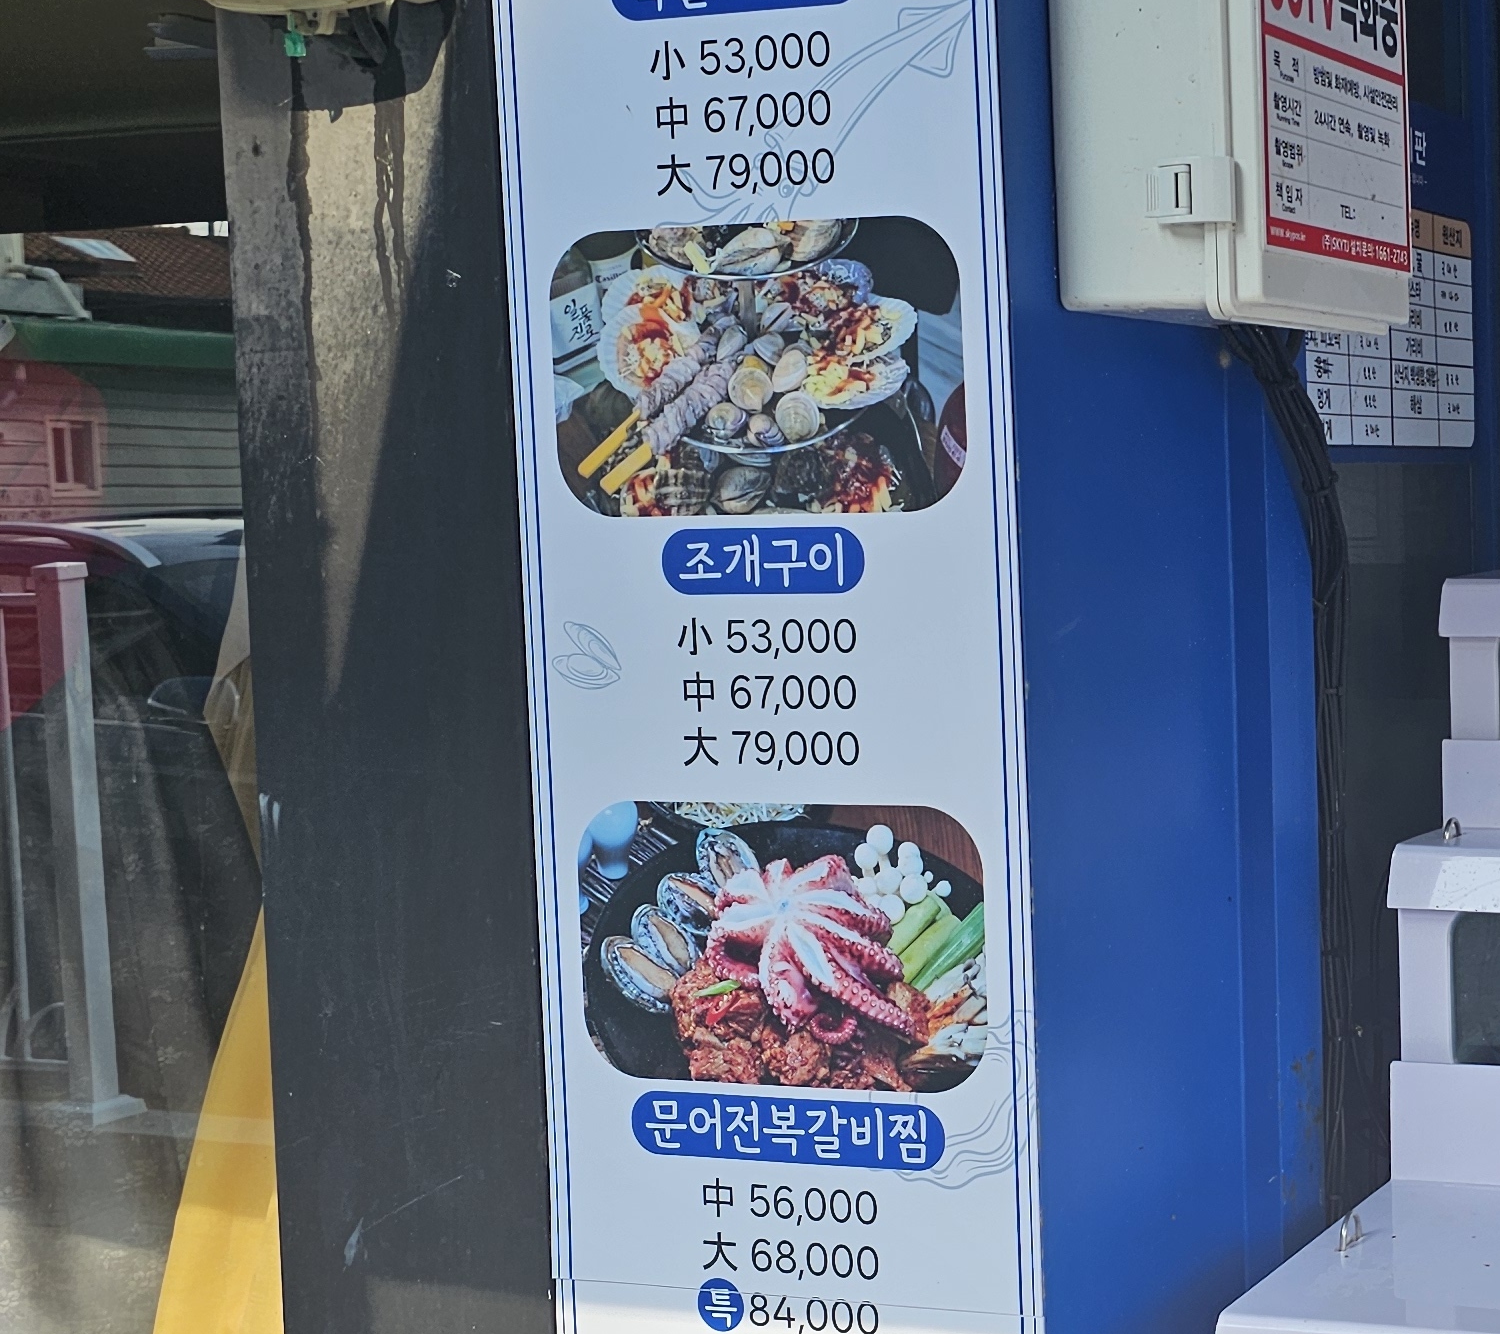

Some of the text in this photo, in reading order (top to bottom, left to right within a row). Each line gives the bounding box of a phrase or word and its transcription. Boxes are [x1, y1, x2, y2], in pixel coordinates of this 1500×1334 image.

[650, 30, 830, 81] 小 53,000
[656, 89, 831, 139] 中 67,000
[1273, 91, 1301, 117] 촬영시간
[1314, 110, 1336, 131] 24시간
[1275, 137, 1303, 163] 촬영범위
[656, 148, 835, 197] 大 79,000
[1340, 204, 1356, 220] TEL:
[1442, 225, 1462, 249] 원산지
[564, 298, 593, 326] 일품
[569, 322, 600, 343] 진로
[679, 532, 844, 588] 조개구이
[677, 617, 857, 660] 小 53,000
[682, 671, 857, 716] 中 67,000
[683, 727, 860, 771] 大 79,000
[645, 1098, 927, 1164] 문어전복갈비찜
[702, 1177, 878, 1226] 中 56,000
[702, 1231, 880, 1280] 大 68,000
[704, 1288, 738, 1329] 특
